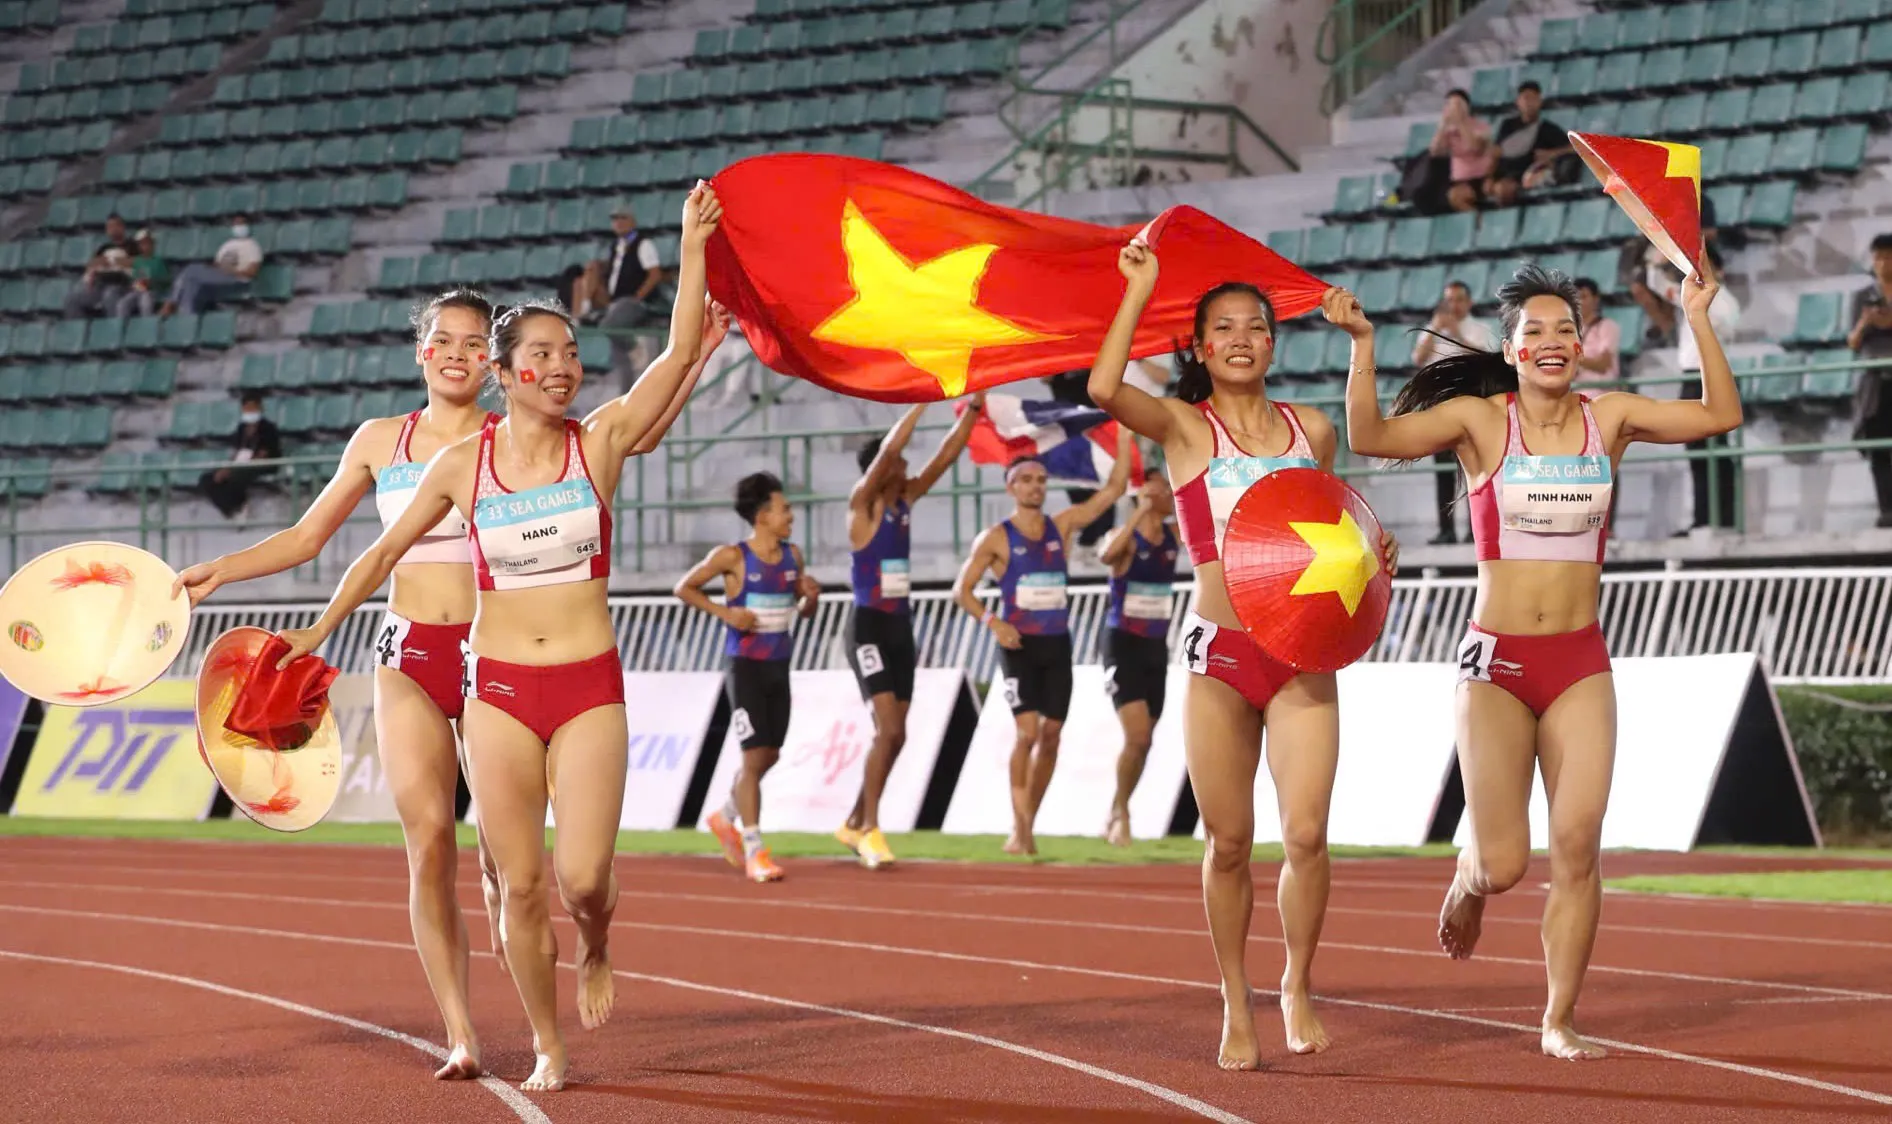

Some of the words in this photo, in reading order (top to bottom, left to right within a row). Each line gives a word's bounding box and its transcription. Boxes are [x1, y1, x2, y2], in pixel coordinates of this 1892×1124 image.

[408, 469, 421, 482] SE
[1538, 464, 1560, 477] SEA
[1564, 464, 1600, 477] GAMES
[508, 501, 535, 517] SEA
[537, 488, 582, 510] GAMES
[1527, 493, 1558, 502] MINH
[1560, 493, 1592, 502] HANH
[1520, 517, 1552, 525] THAILAND
[522, 526, 558, 541] HANG
[576, 543, 595, 554] 649
[504, 557, 538, 568] THAILAND
[1184, 626, 1205, 669] 4
[862, 648, 877, 671] 5
[1460, 641, 1483, 676] 4
